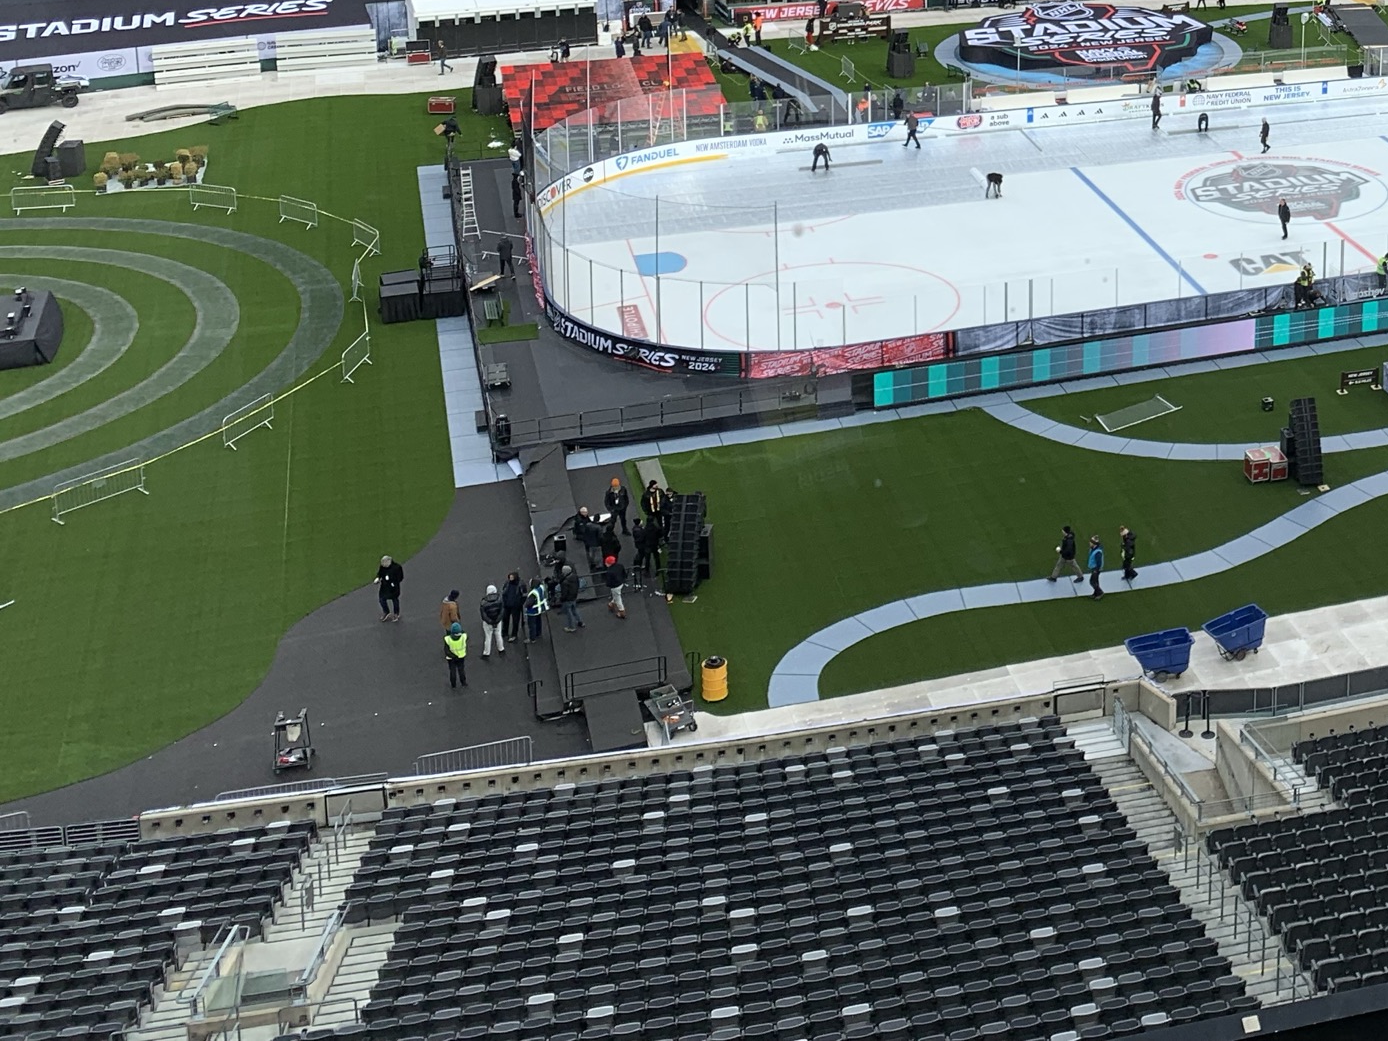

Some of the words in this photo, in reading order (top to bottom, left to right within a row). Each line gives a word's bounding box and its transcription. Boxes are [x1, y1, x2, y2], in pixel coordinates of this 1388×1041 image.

[1050, 5, 1077, 17] NHL
[0, 12, 174, 42] STADIUM
[965, 15, 1207, 46] STADIUM
[1020, 28, 1172, 47] SERIES
[1115, 35, 1171, 44] JERSEY
[1231, 97, 1251, 105] UNION
[989, 119, 1010, 127] above
[794, 129, 854, 143] MassMutual
[867, 125, 890, 137] SAP
[696, 143, 708, 152] NEW
[709, 140, 748, 151] AMSTERDAM
[631, 148, 679, 165] FANDUEL
[1249, 165, 1271, 176] NHL
[537, 178, 571, 208] DISCOVER
[1193, 172, 1367, 202] STADIUM
[1231, 182, 1344, 202] SERIES
[1229, 251, 1307, 276] CAT
[561, 318, 612, 354] STADIUM
[688, 362, 716, 371] 2024
[760, 355, 802, 370] STADIUM
[762, 364, 799, 377] SERIES
